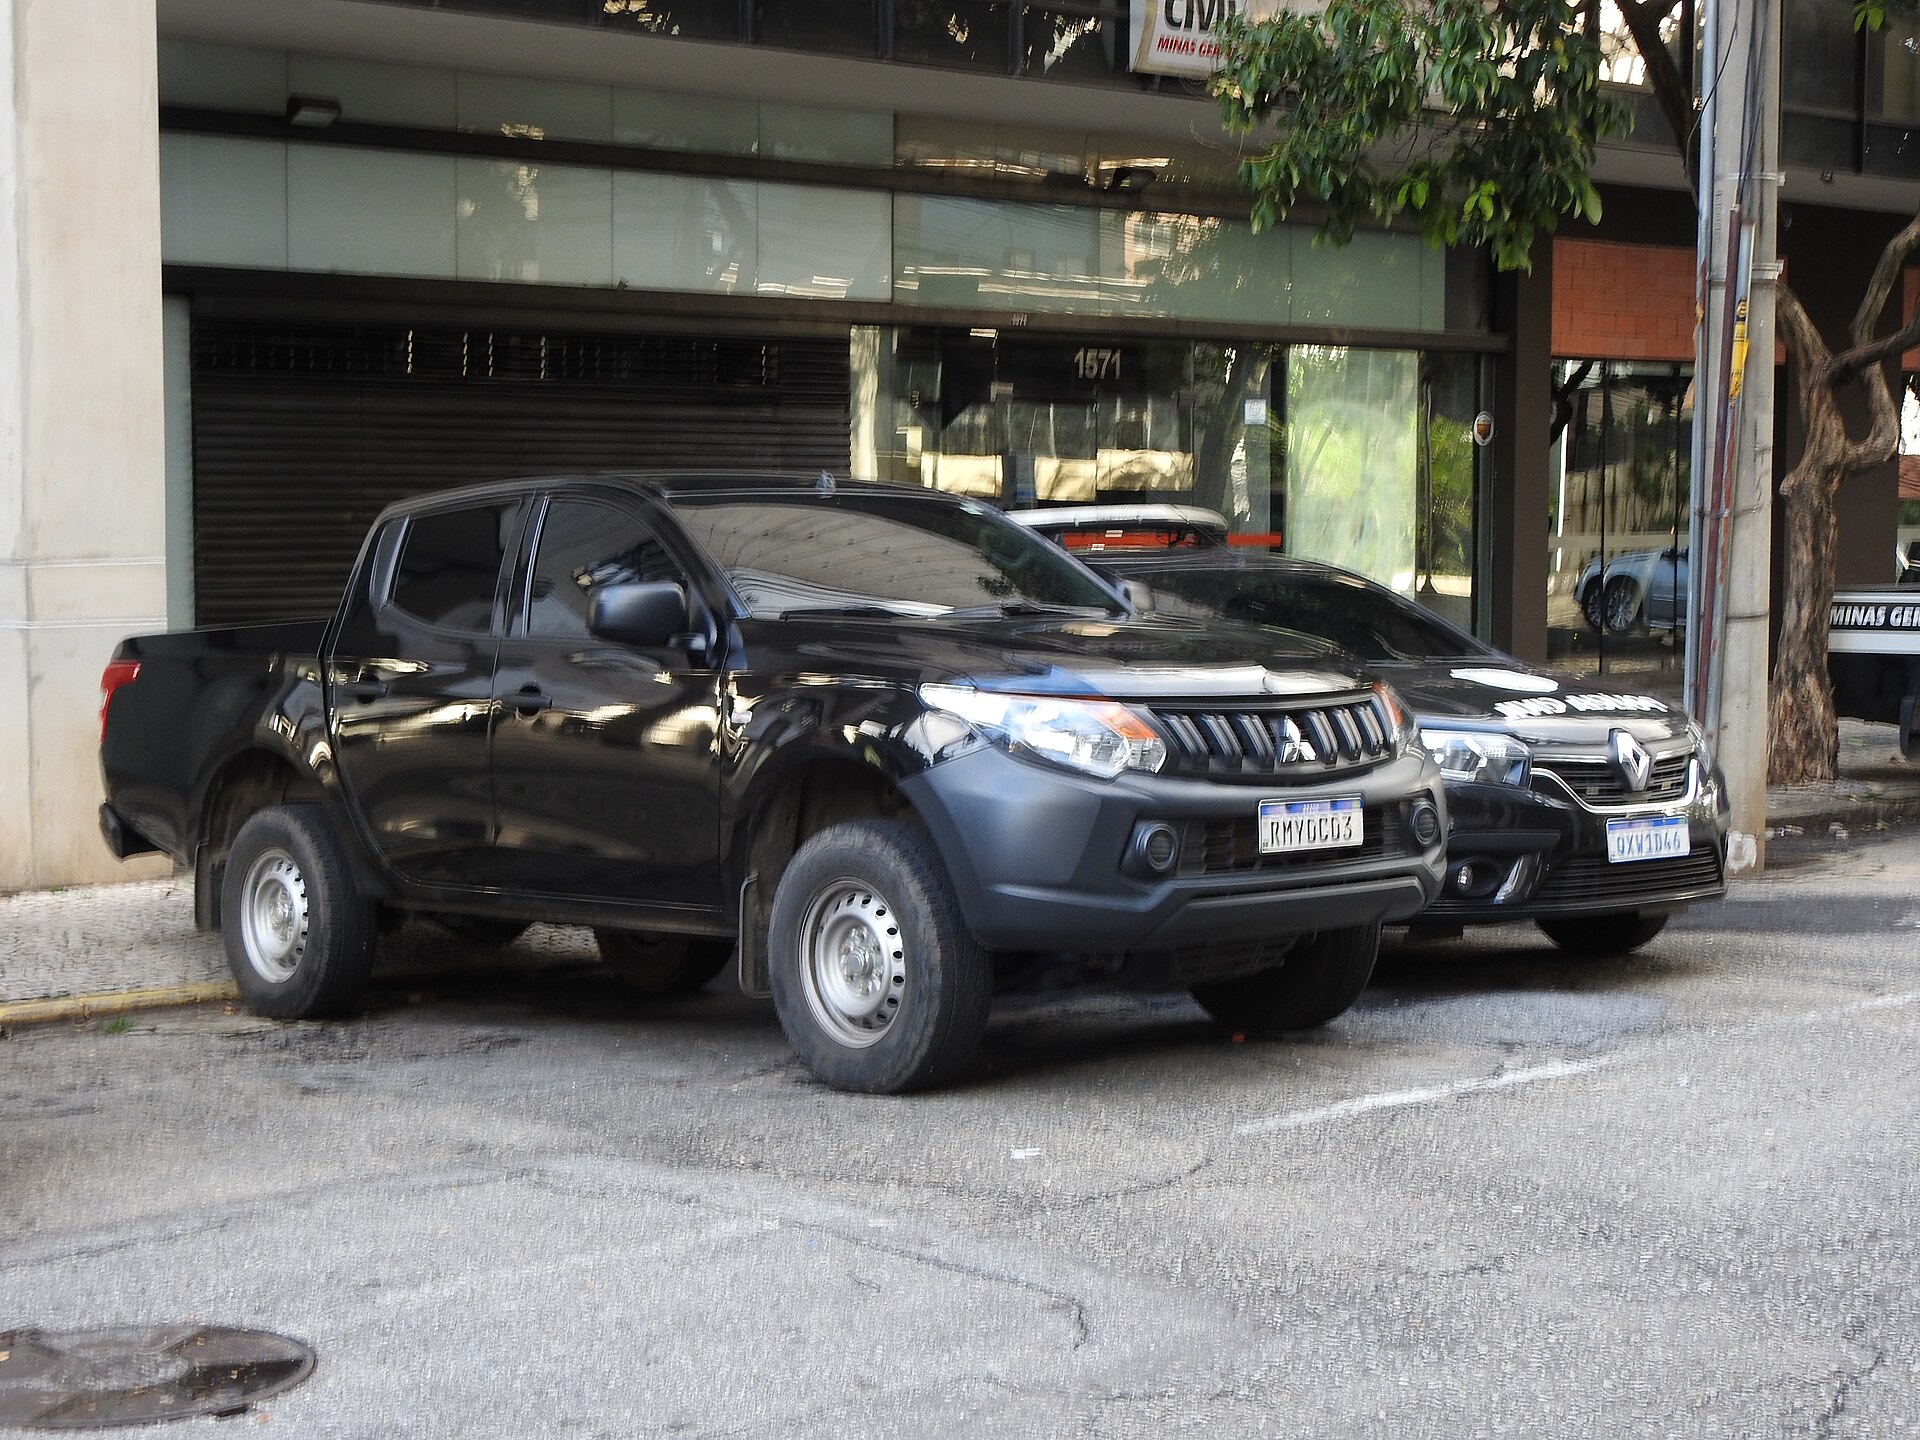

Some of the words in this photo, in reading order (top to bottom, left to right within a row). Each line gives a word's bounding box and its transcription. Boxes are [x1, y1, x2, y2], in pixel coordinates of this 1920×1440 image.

[1157, 36, 1196, 54] MINAS
[1074, 347, 1121, 379] 1571
[1829, 605, 1886, 627] MINAS
